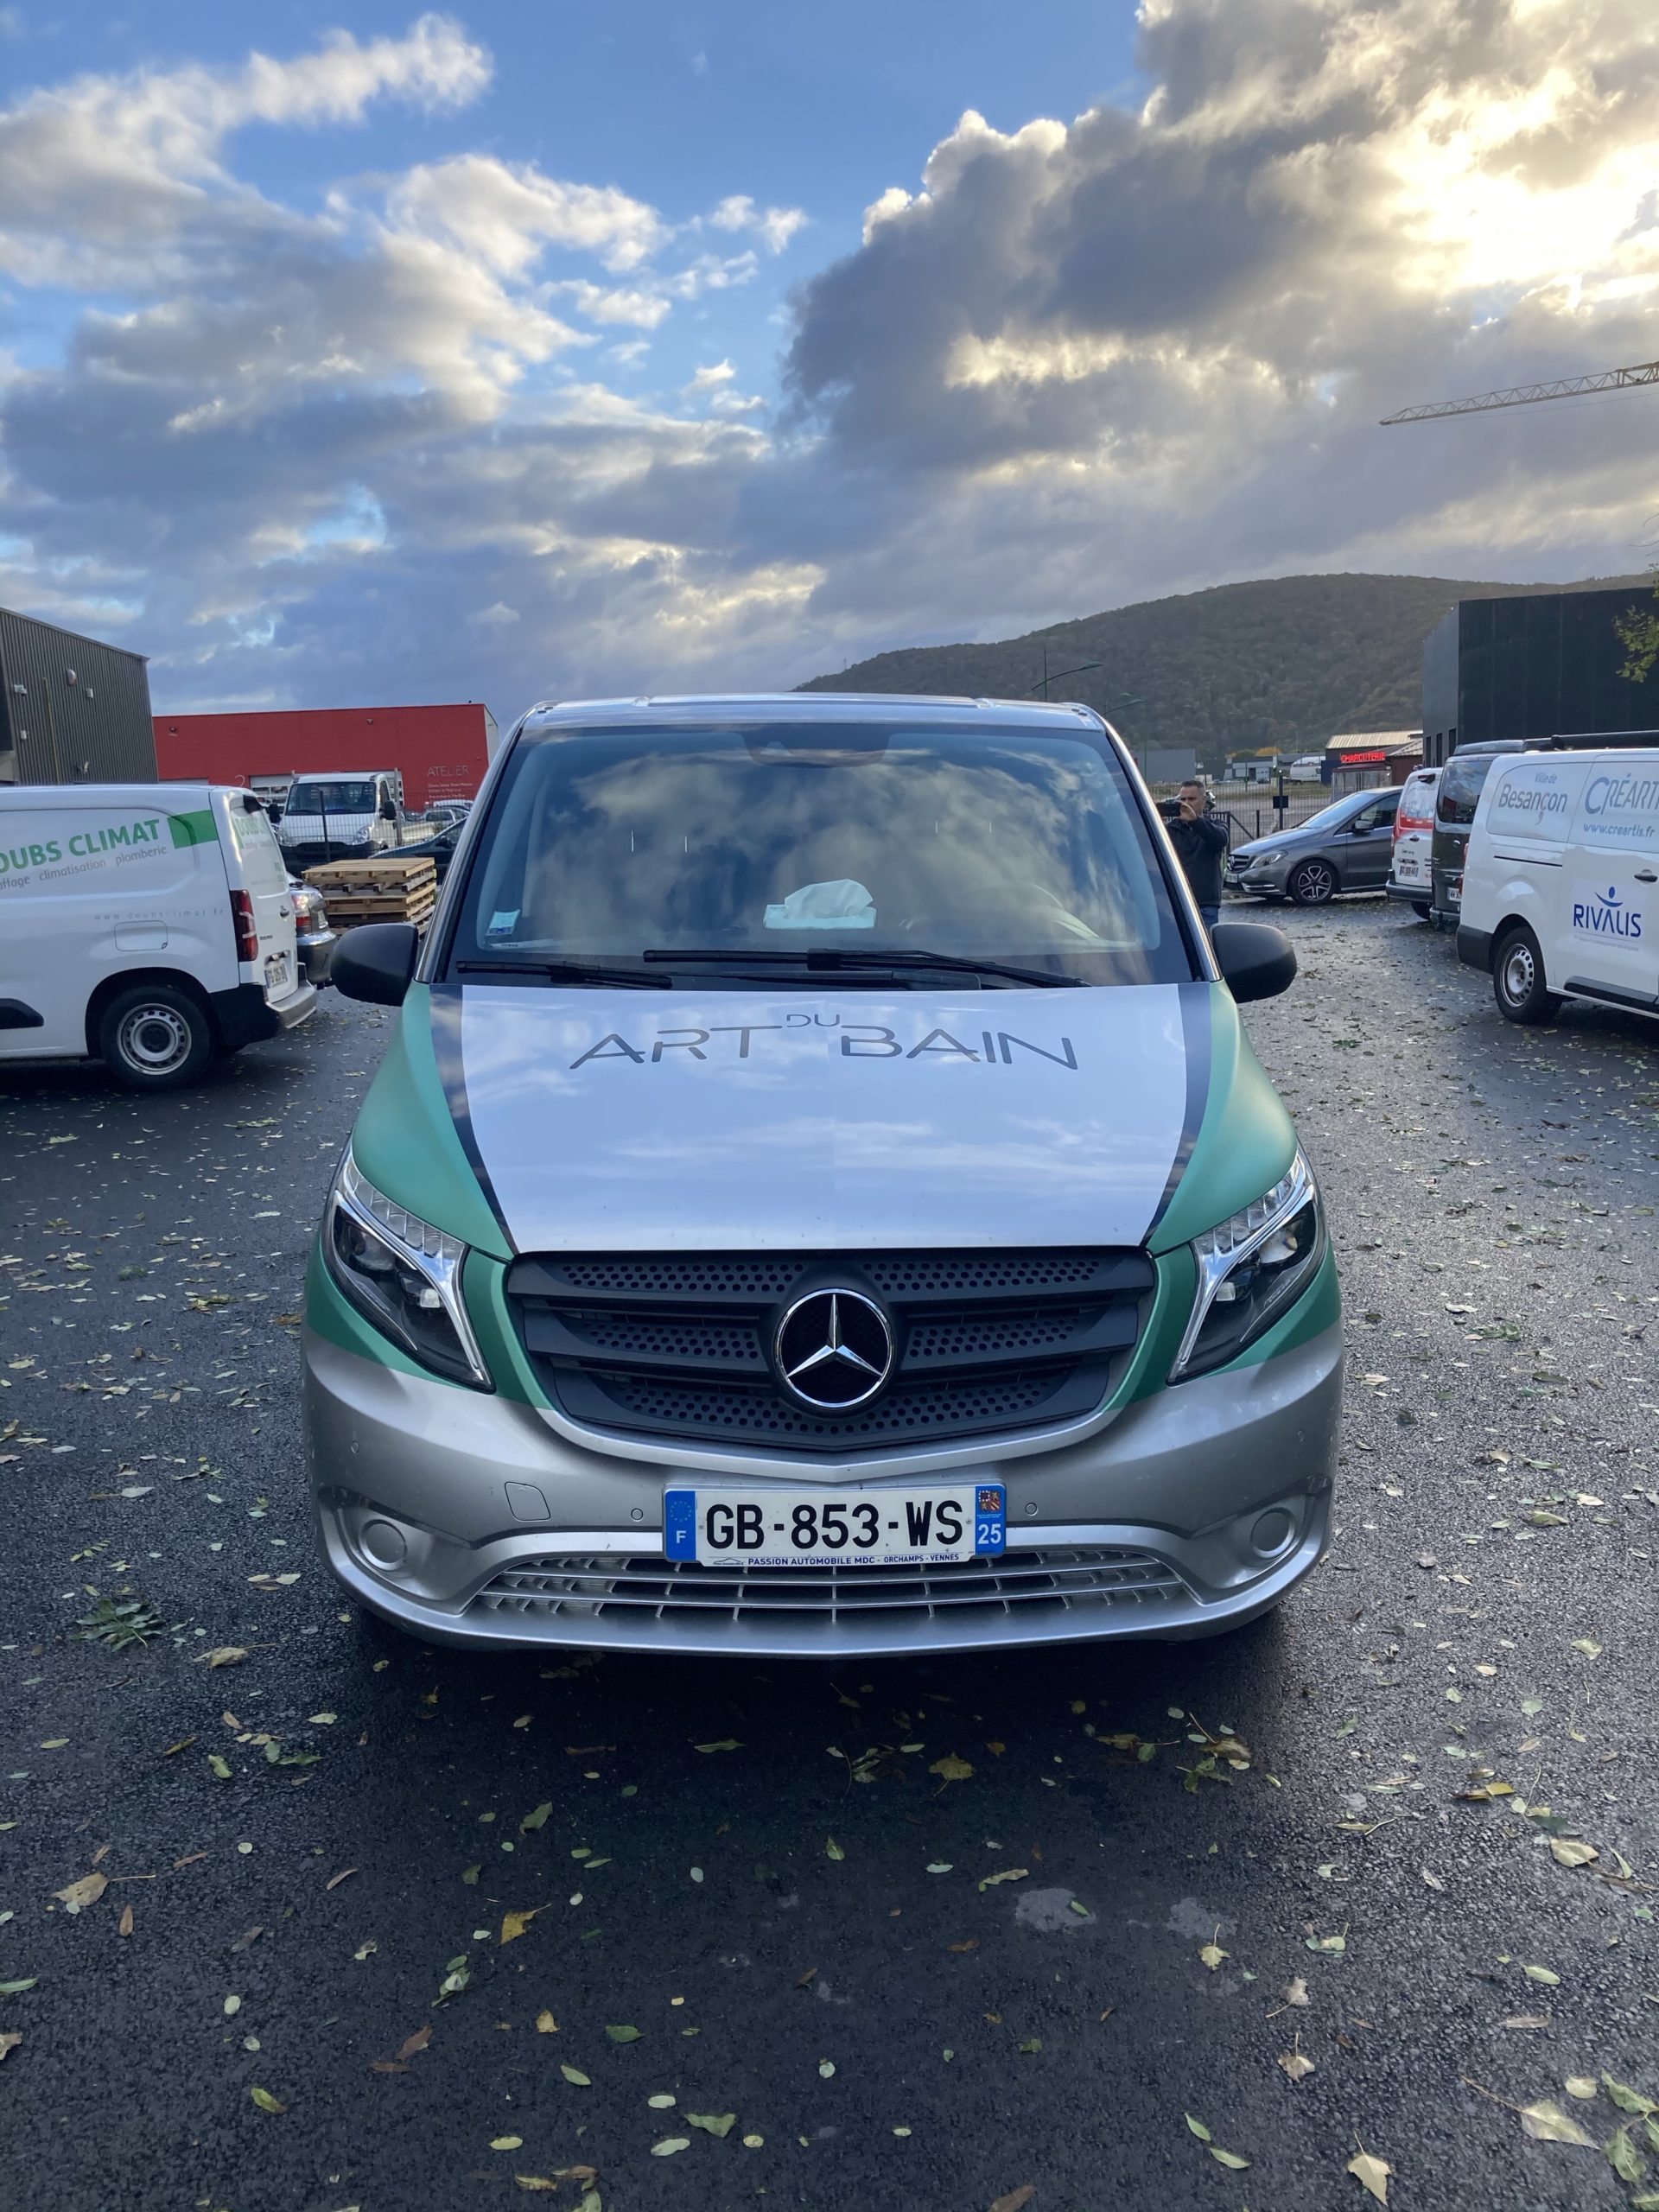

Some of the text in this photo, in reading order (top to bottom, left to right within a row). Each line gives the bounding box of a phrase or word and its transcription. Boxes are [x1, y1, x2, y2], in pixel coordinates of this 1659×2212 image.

[1535, 772, 1557, 784] Ville de
[1498, 784, 1567, 825] Besançon
[68, 819, 160, 857] CLIMAT
[39, 858, 106, 881] climatisation
[116, 845, 168, 867] plomberie
[1573, 903, 1642, 938] RIVALIS
[569, 1014, 1078, 1071] ART DU BAIN
[676, 1530, 687, 1543] F
[977, 1523, 1002, 1545] 25
[791, 1557, 852, 1566] AUTOMOBILE
